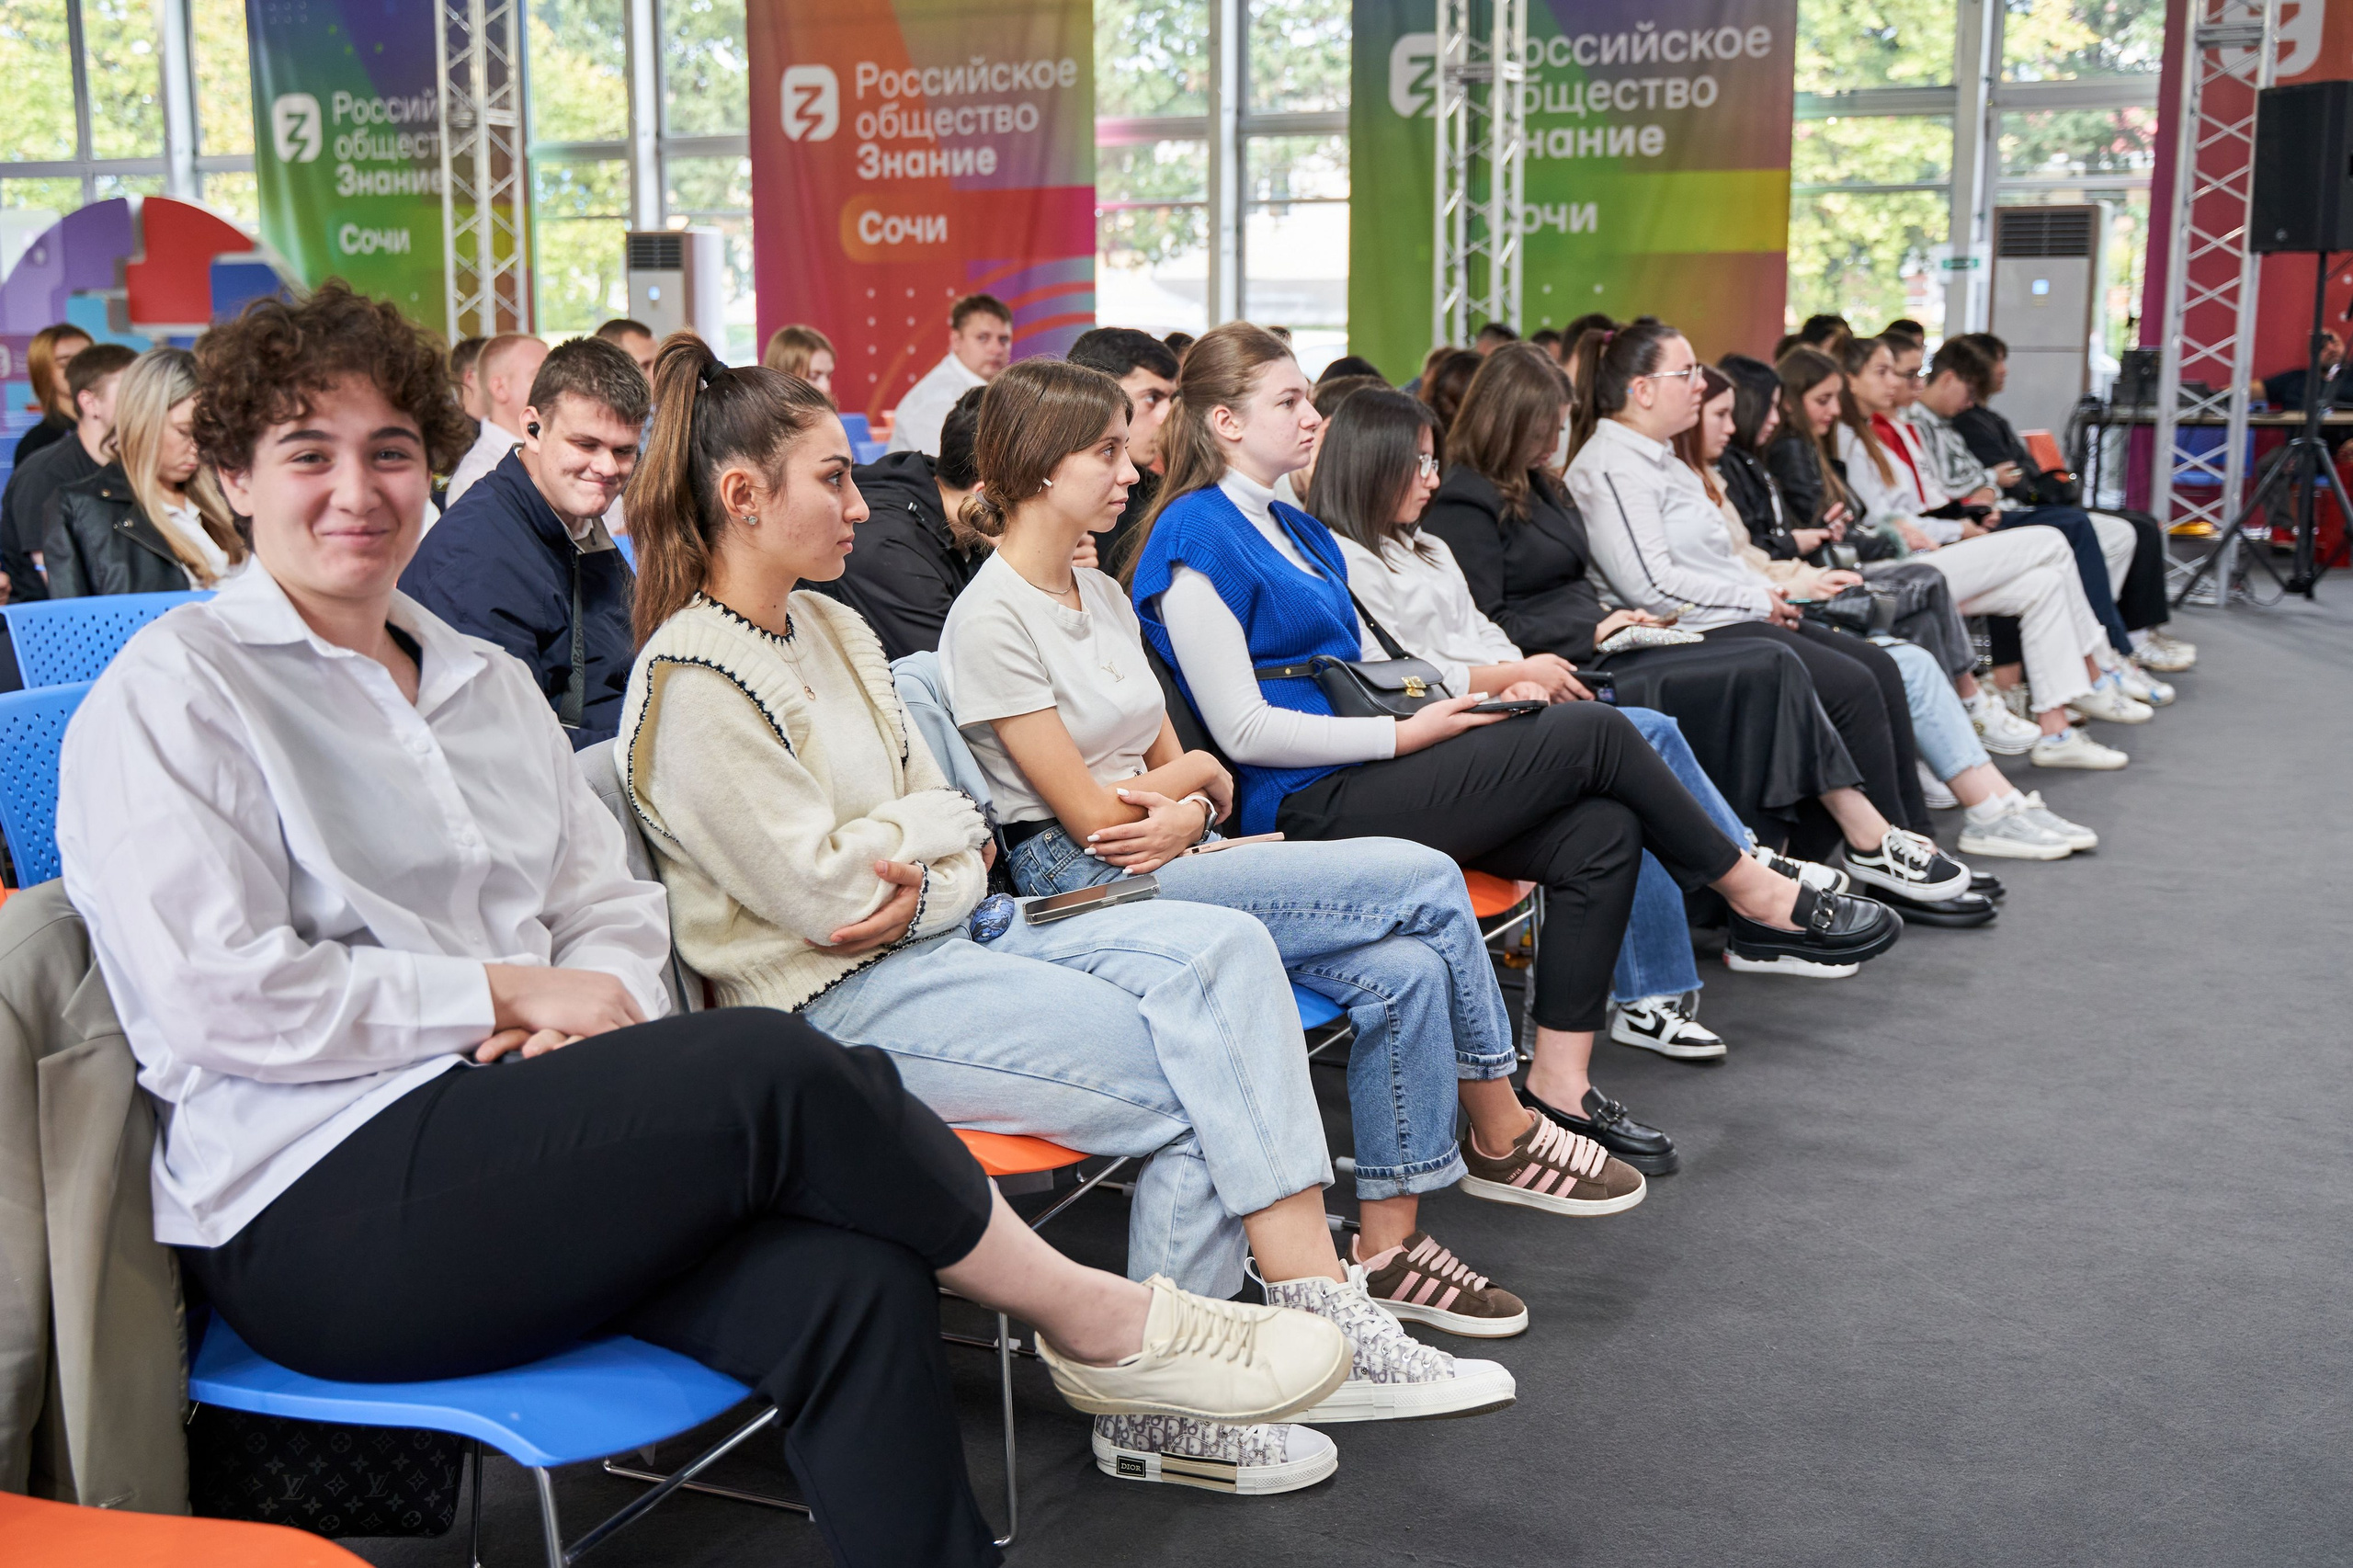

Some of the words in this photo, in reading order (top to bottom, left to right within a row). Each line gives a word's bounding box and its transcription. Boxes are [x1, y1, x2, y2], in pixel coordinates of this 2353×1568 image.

[1491, 20, 1772, 69] оссийское
[855, 55, 1078, 100] Российское
[333, 86, 473, 126] Россий
[855, 100, 1040, 142] общество
[334, 123, 480, 164] общест
[856, 142, 998, 180] Знание
[338, 222, 413, 256] Сочи
[858, 209, 948, 245] Сочи
[1120, 1461, 1142, 1472] DIOR
